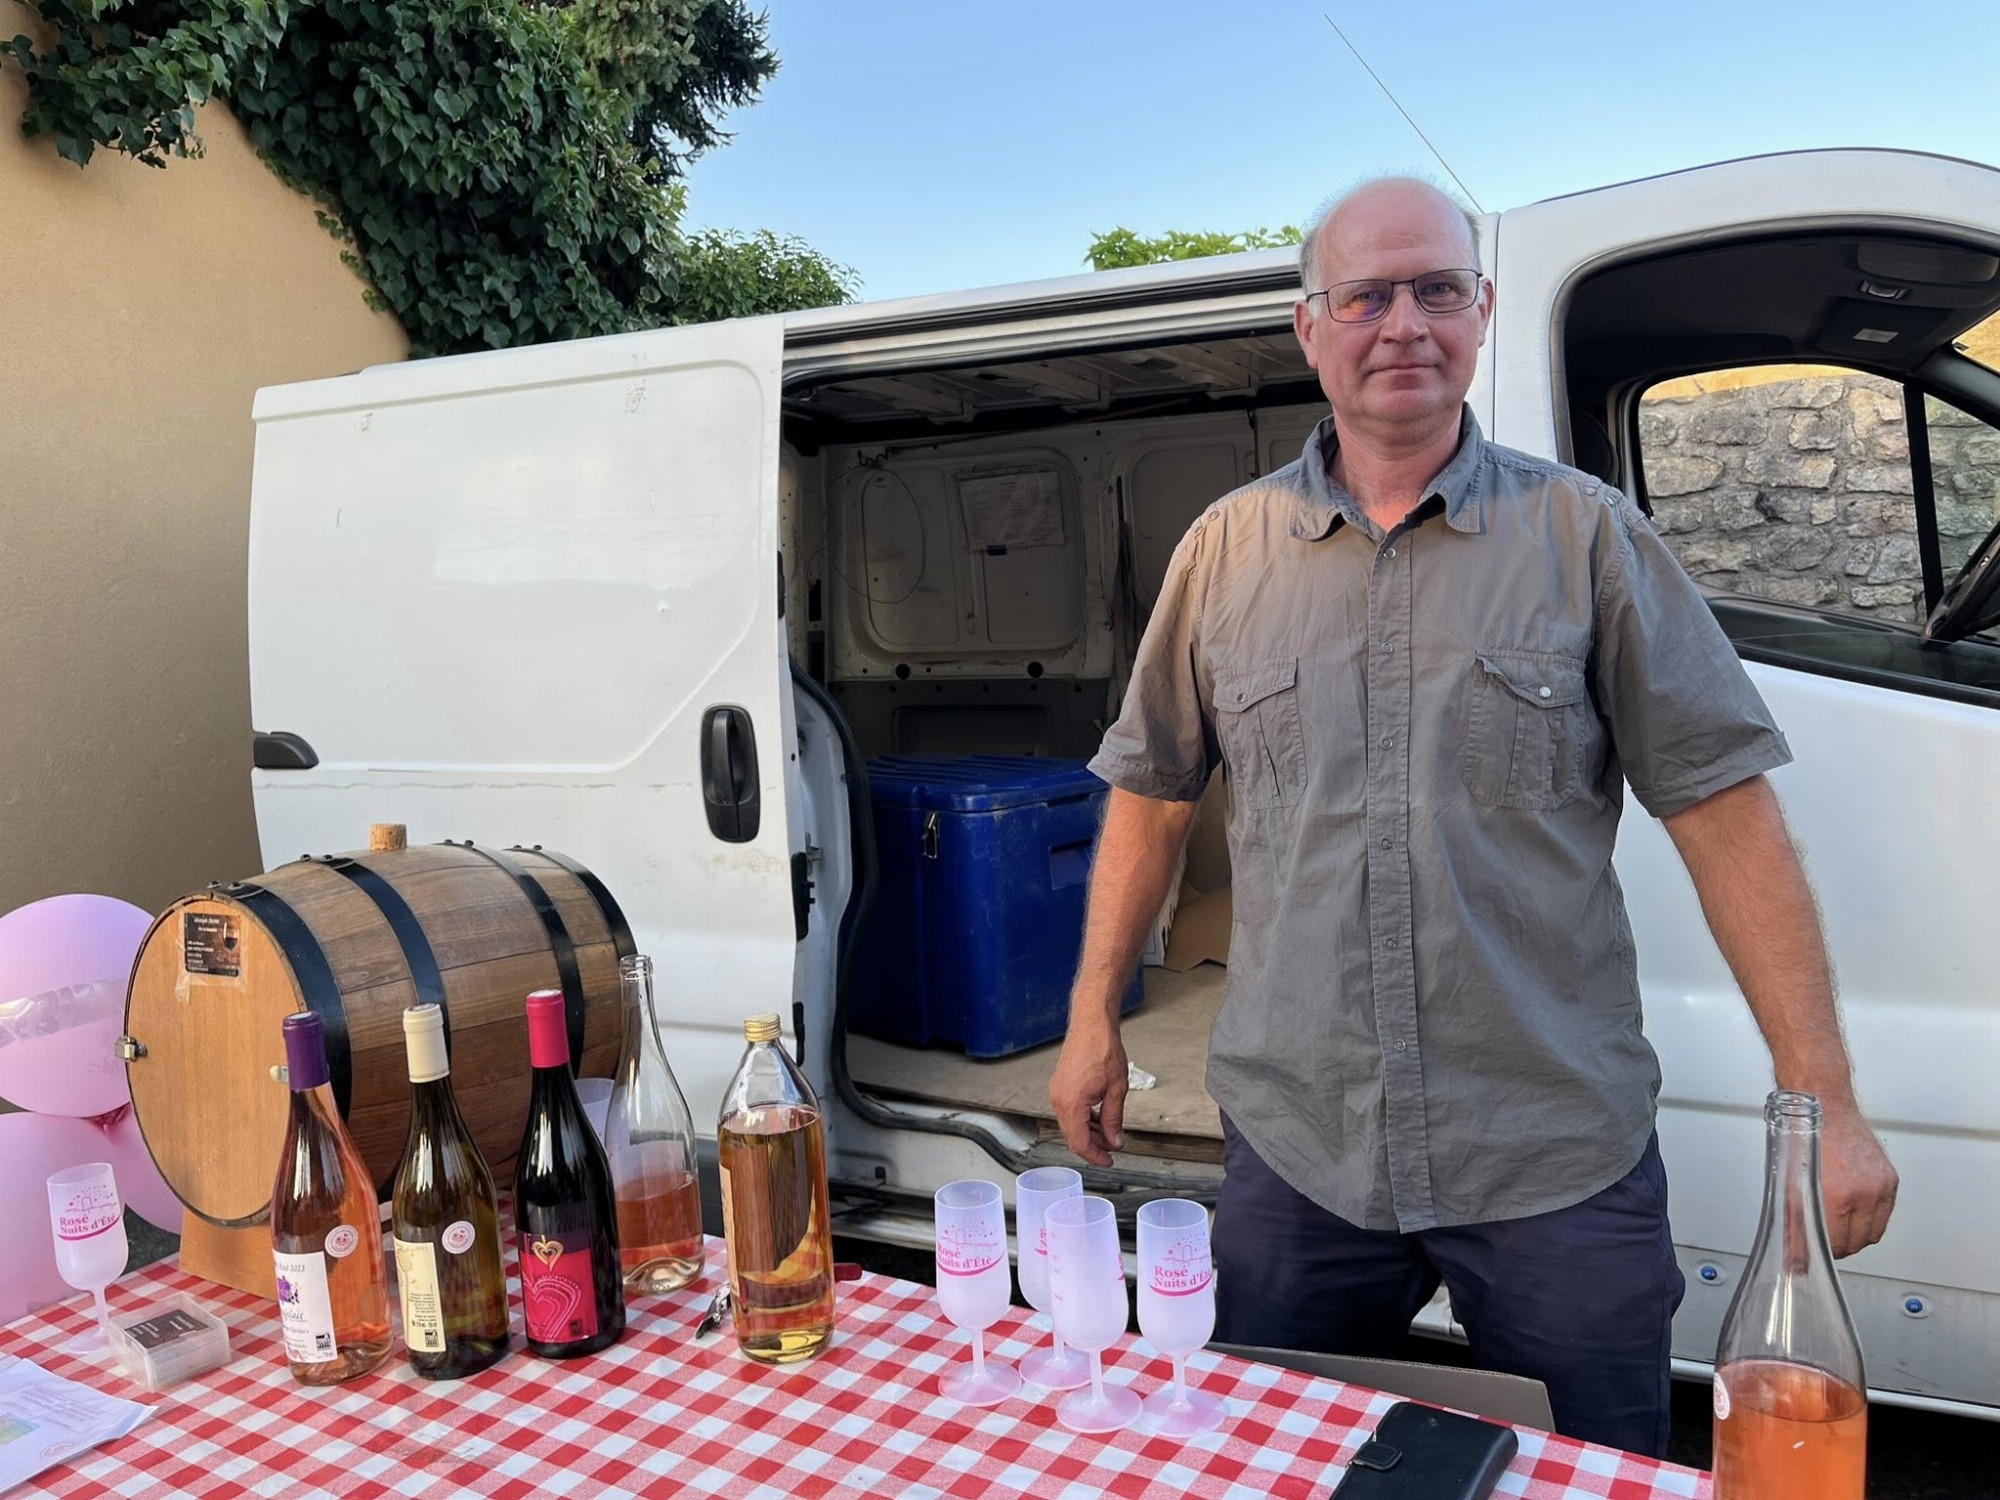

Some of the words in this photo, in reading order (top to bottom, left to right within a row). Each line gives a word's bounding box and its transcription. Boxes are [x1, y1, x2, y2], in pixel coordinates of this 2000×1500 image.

[59, 1213, 88, 1226] Rosé
[60, 1225, 88, 1235] Nuits
[91, 1213, 116, 1230] d'Été
[963, 1256, 992, 1269] d'Été
[1154, 1265, 1188, 1278] Rosé
[1154, 1276, 1187, 1289] Nuits
